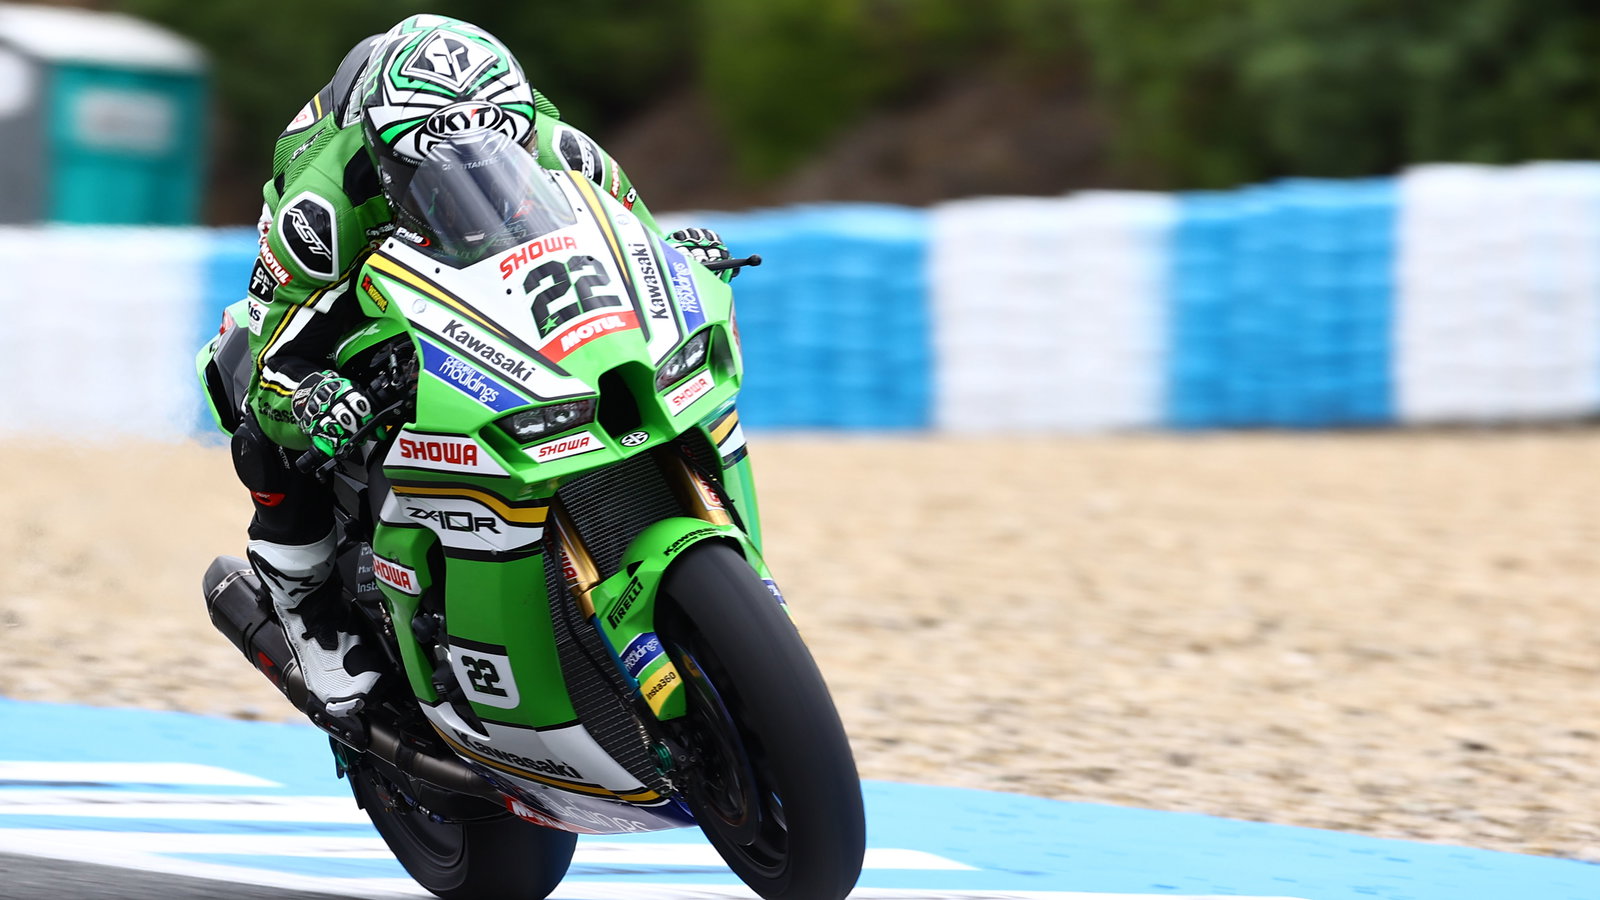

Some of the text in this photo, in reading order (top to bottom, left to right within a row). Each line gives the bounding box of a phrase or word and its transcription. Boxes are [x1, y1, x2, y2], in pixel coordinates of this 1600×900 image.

[436, 106, 494, 134] KYT
[287, 207, 332, 261] RST
[260, 242, 289, 284] MOTUL
[499, 236, 577, 280] SHOWA
[522, 255, 622, 340] 22
[628, 243, 669, 320] Kawasaki
[442, 319, 536, 382] Kawasaki
[560, 314, 626, 352] MOTUL
[438, 362, 500, 403] mouldings
[672, 378, 708, 407] SHOWA
[399, 438, 477, 466] SHOWA
[538, 436, 590, 458] SHOWA
[606, 576, 644, 630] PIRELLI
[461, 655, 508, 698] 22
[453, 728, 584, 780] Kawasaki
